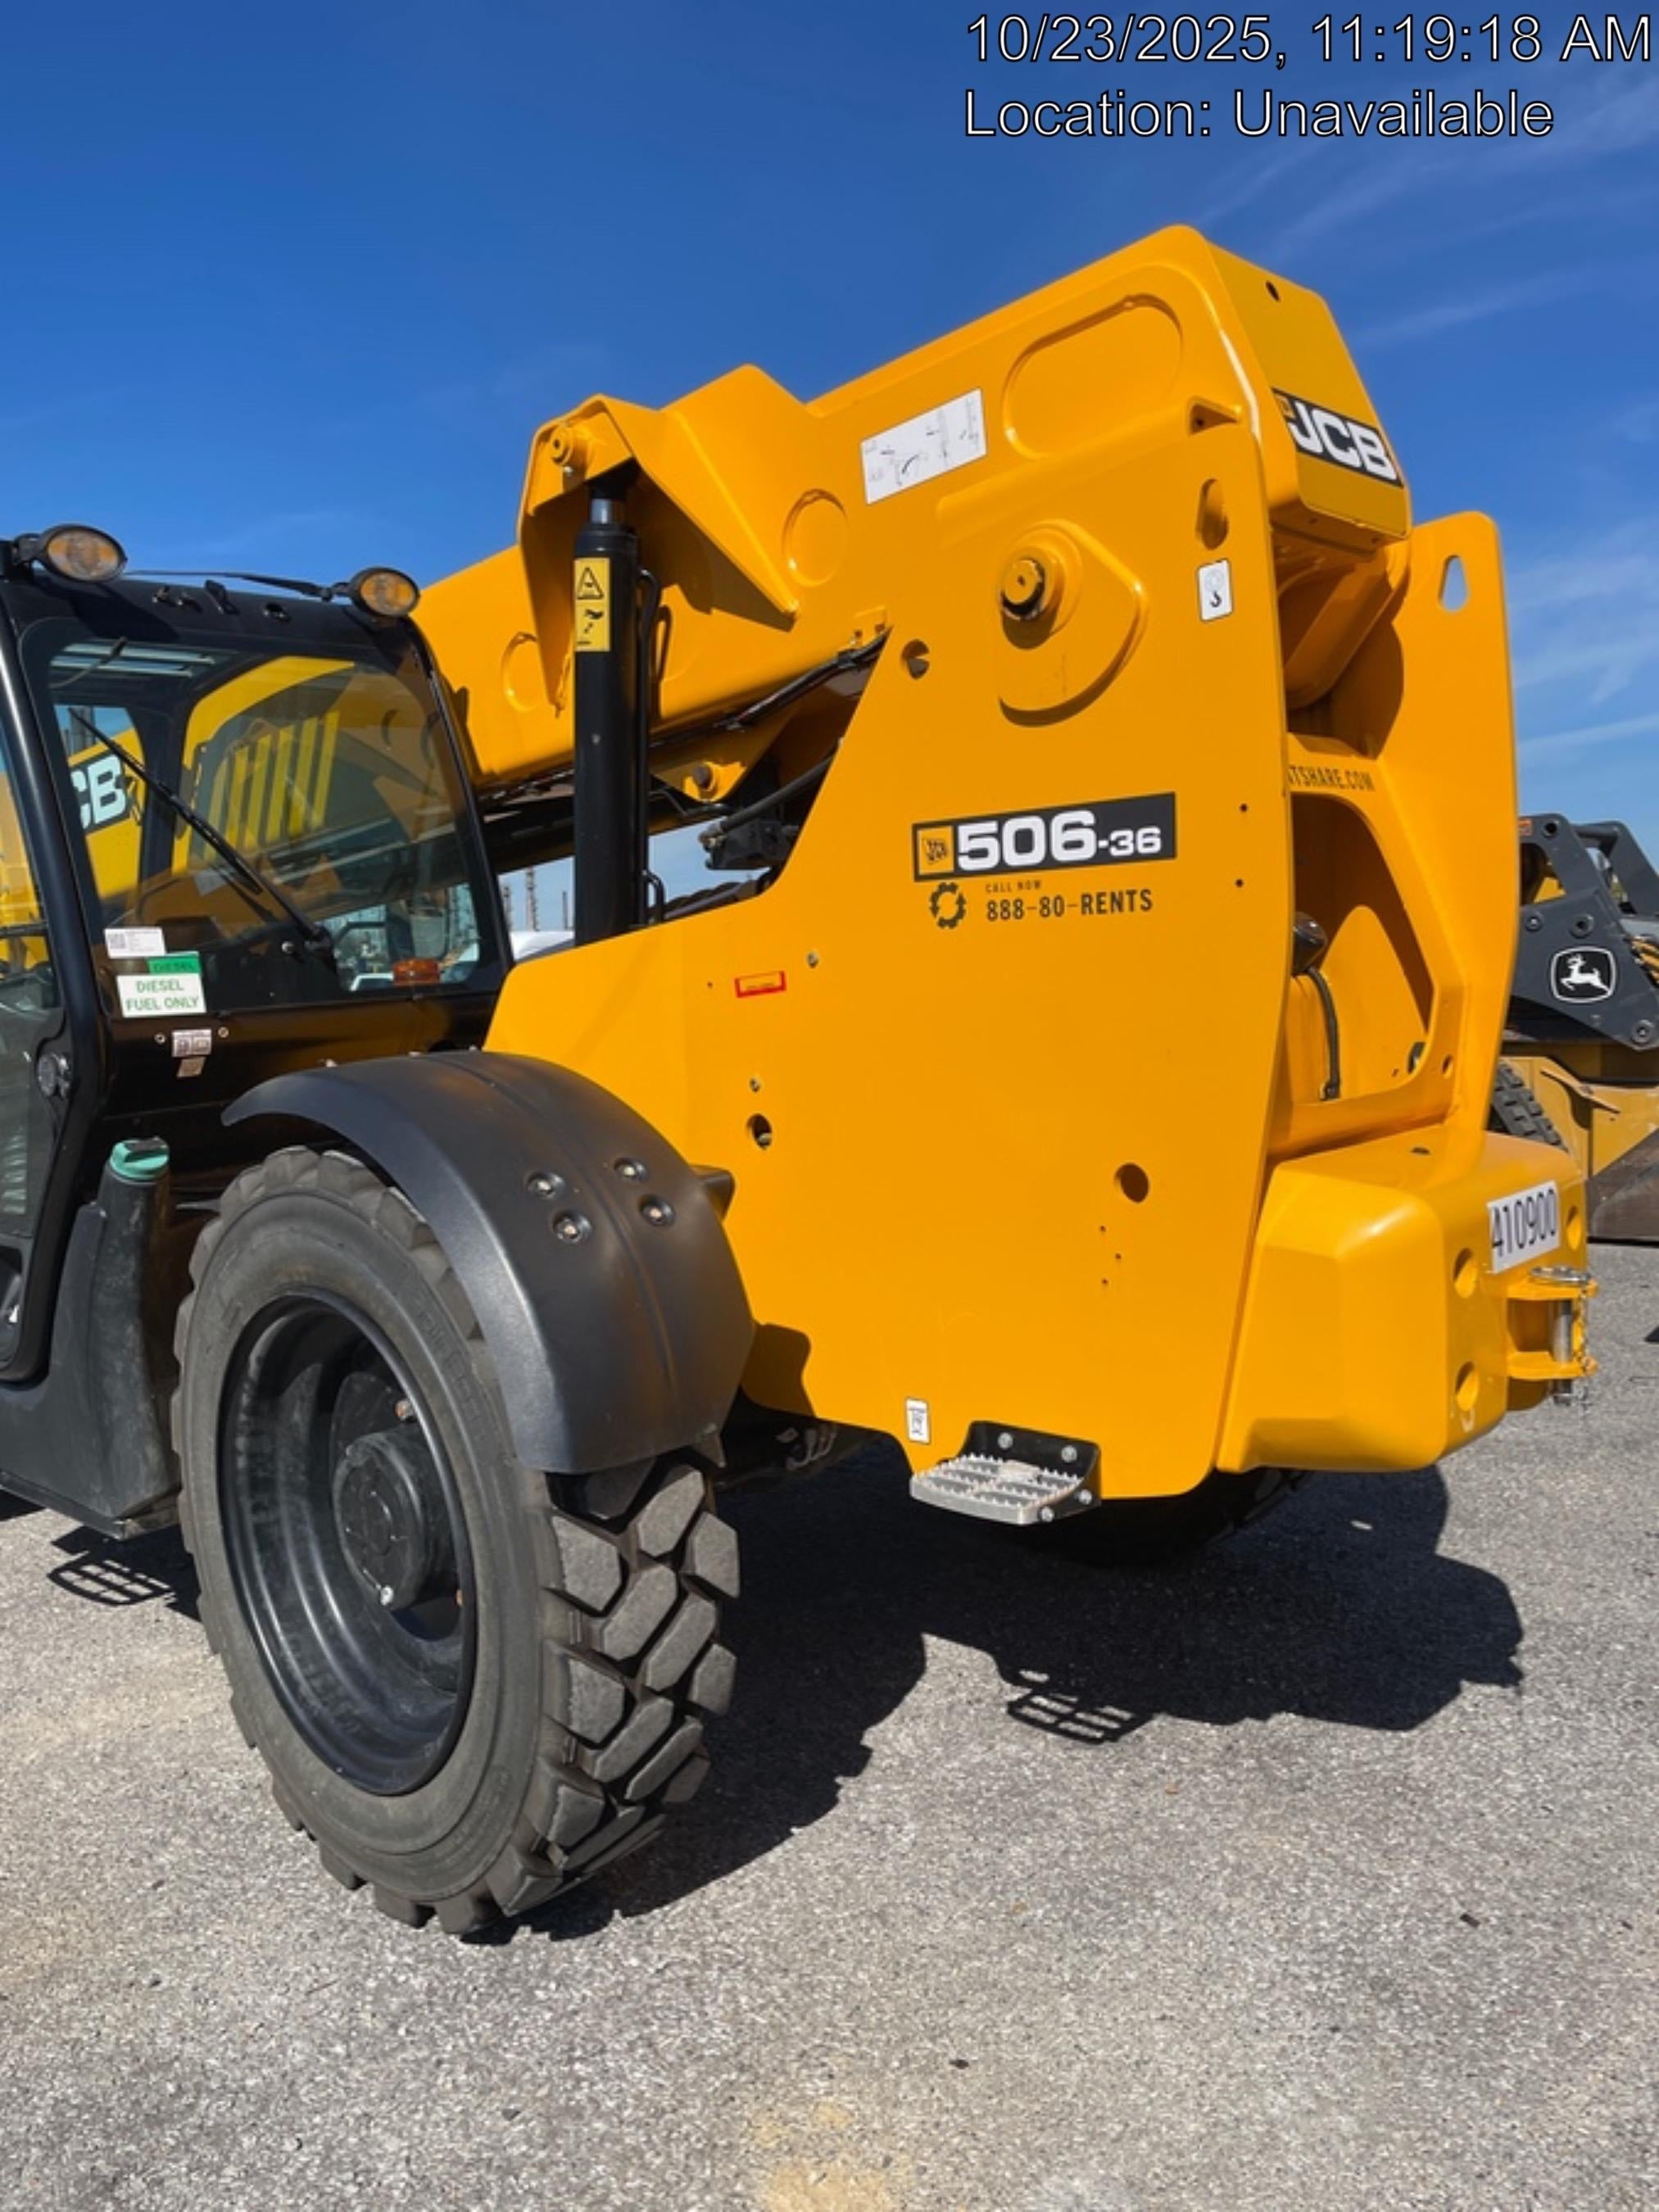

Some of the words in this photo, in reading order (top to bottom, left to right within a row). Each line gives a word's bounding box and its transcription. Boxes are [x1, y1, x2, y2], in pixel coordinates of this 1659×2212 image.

[1287, 399, 1398, 481] JCB
[957, 809, 1162, 870] 506-36
[986, 882, 1013, 894] CALL
[1017, 879, 1041, 891] NOW
[986, 888, 1154, 922] 888-80-RENTS
[136, 979, 184, 993] DIESEL
[125, 999, 160, 1011] FUEL
[164, 997, 199, 1009] ONLY
[1492, 1189, 1557, 1257] 410900
